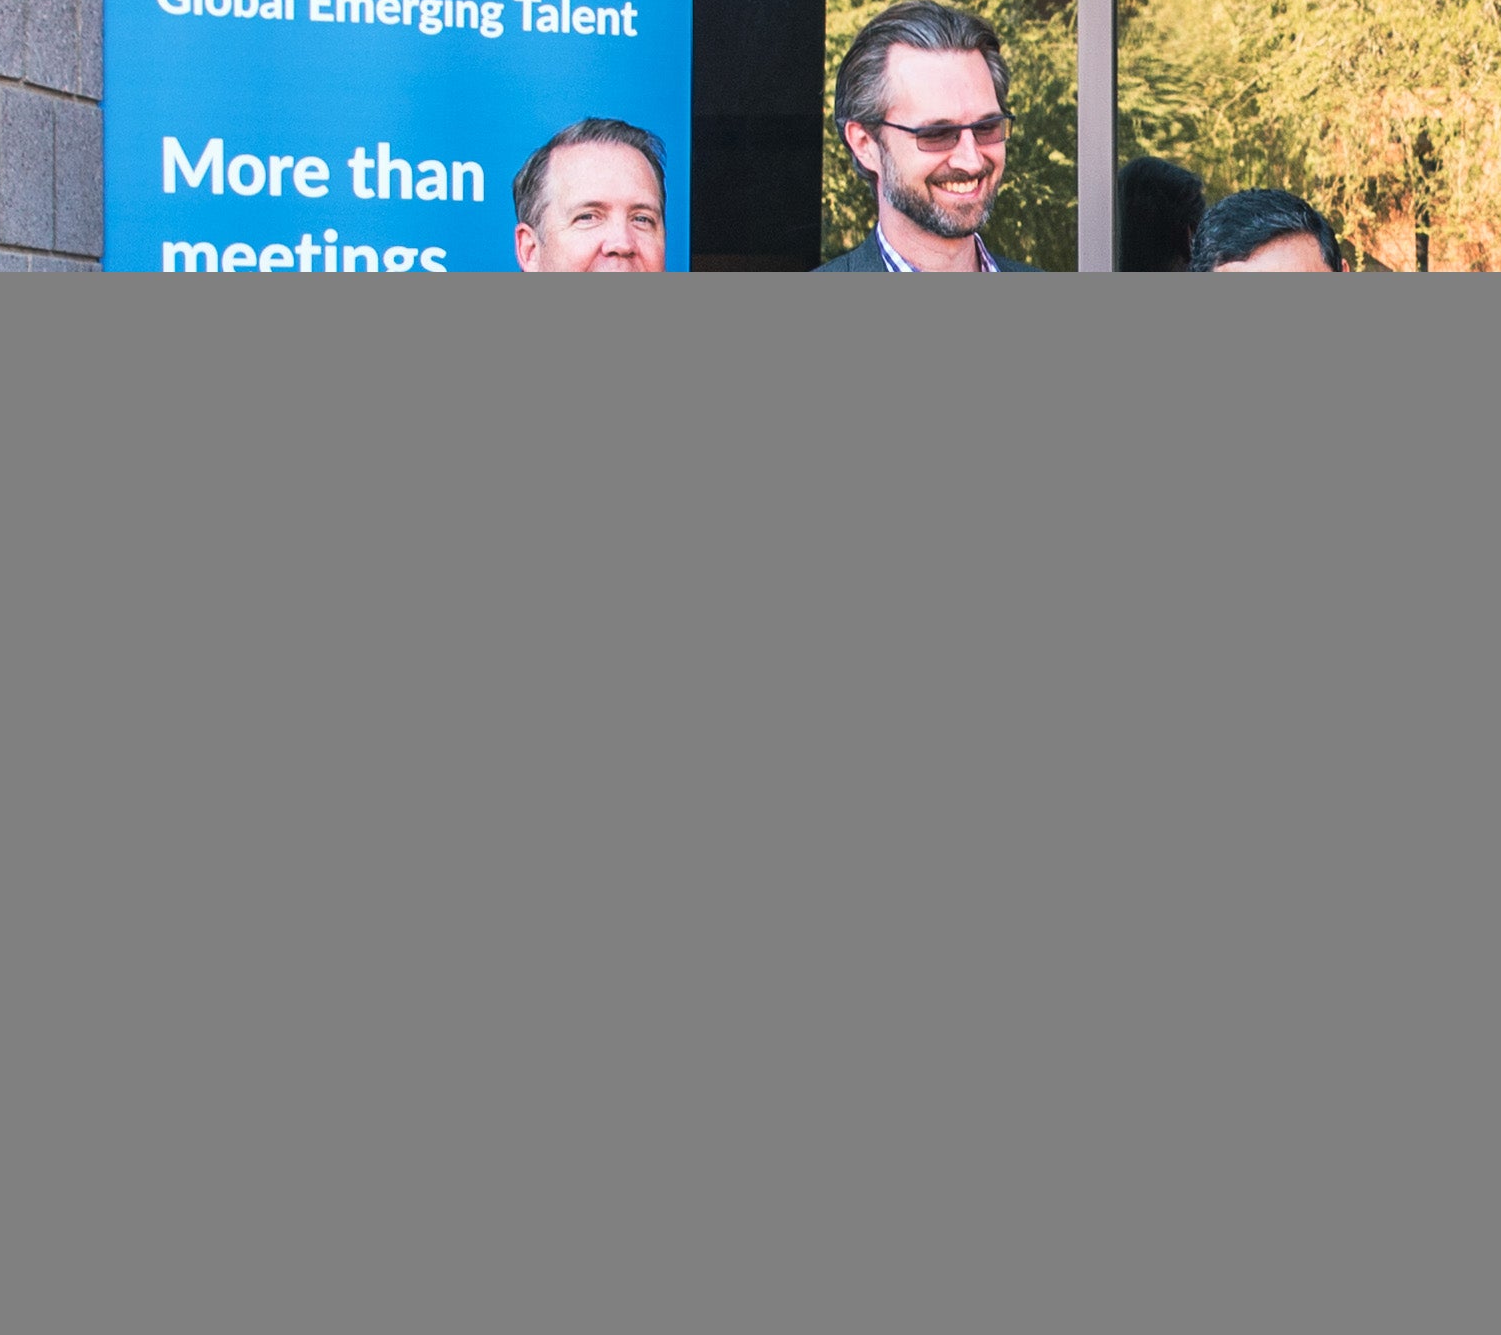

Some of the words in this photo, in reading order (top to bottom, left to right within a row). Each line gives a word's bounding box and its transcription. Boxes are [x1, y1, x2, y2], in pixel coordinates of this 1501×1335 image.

[162, 136, 331, 199] More
[347, 142, 485, 202] than
[162, 228, 448, 273] meetings
